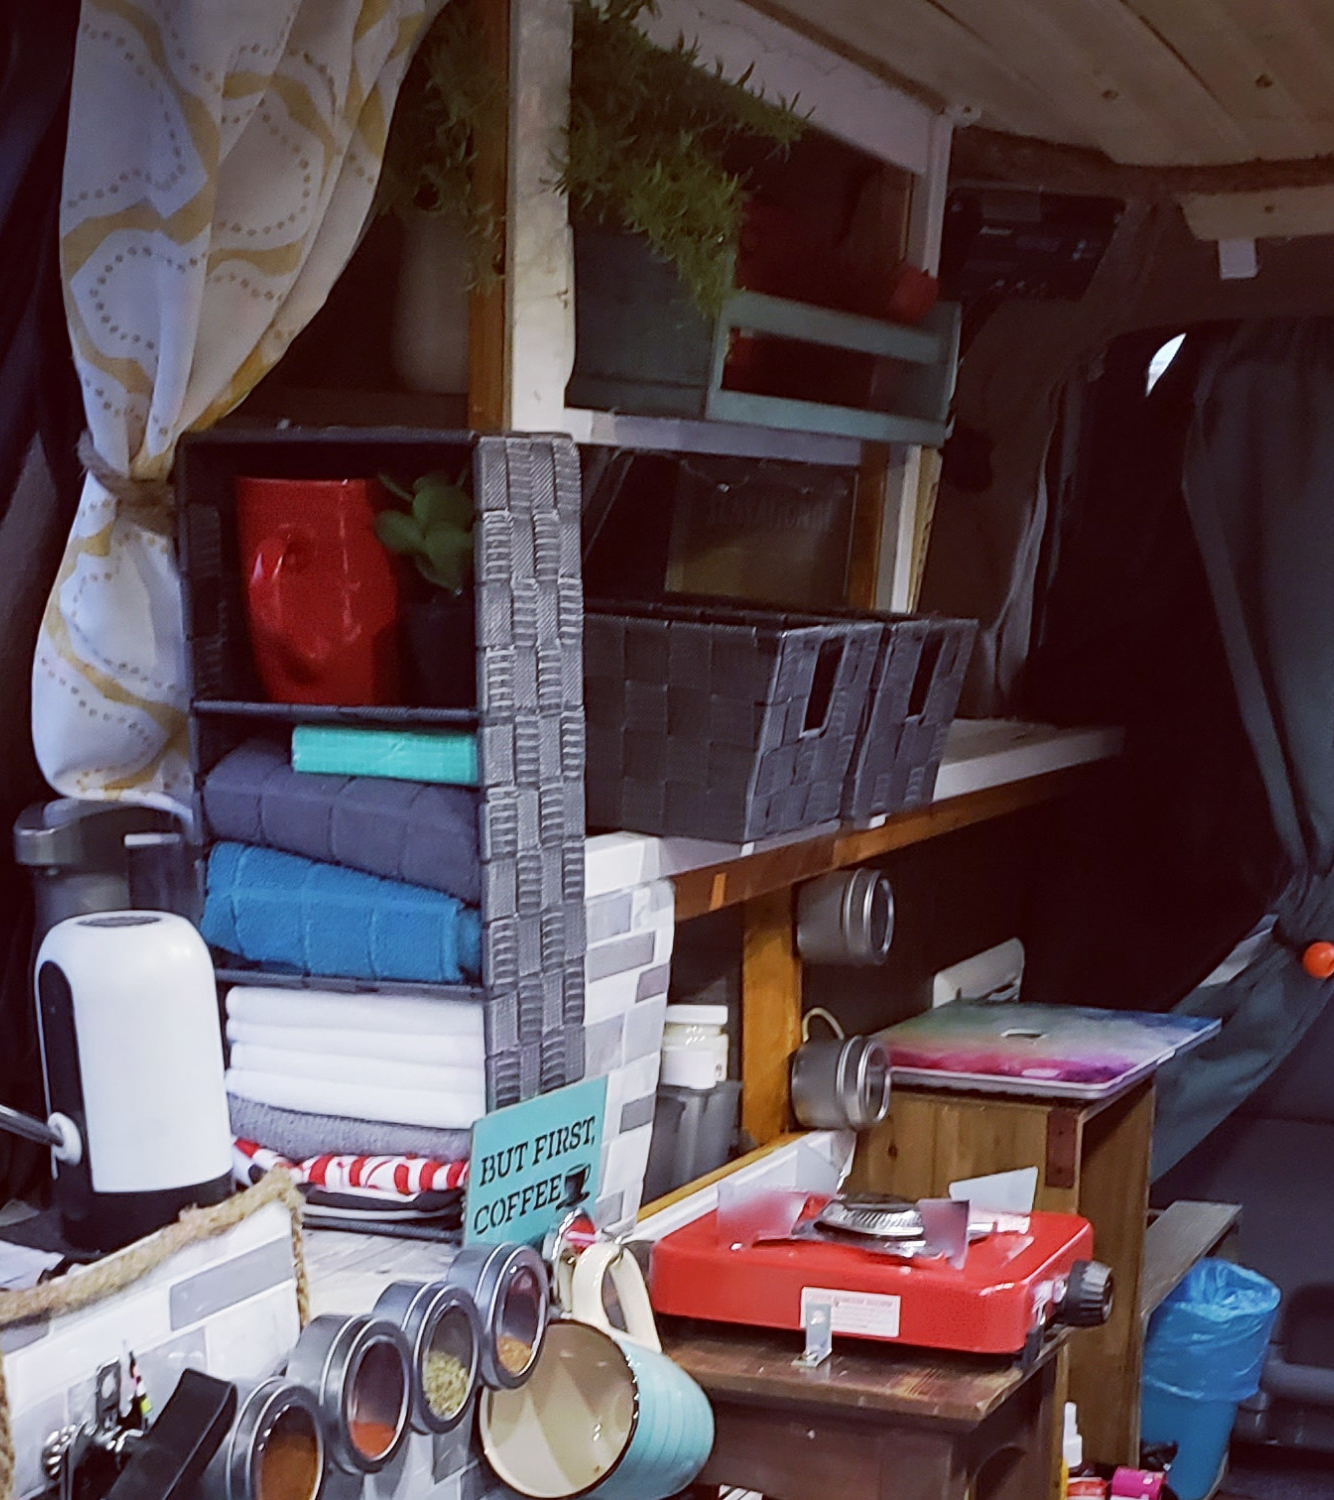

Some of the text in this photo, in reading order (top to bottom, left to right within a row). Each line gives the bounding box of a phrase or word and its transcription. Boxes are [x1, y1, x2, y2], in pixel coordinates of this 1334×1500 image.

[479, 1115, 596, 1187] BUT FIRST,
[474, 1173, 563, 1236] COFFEE
